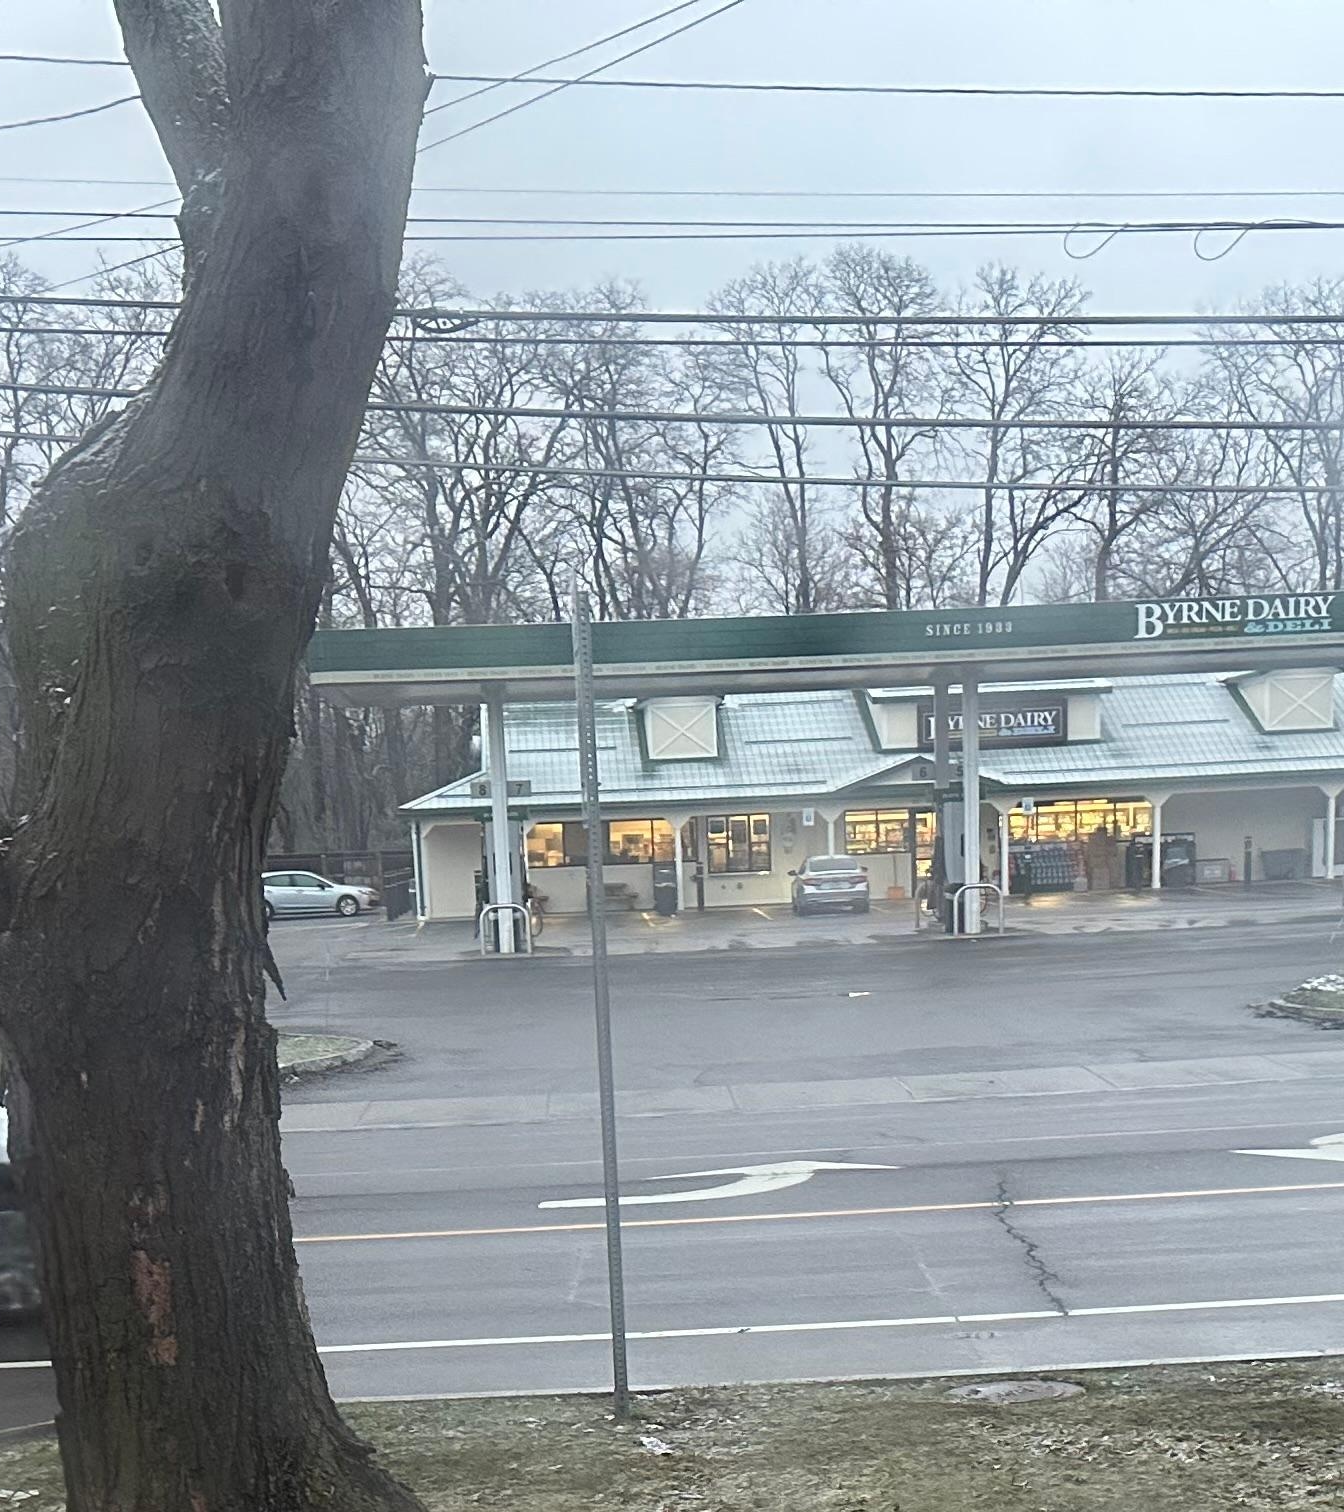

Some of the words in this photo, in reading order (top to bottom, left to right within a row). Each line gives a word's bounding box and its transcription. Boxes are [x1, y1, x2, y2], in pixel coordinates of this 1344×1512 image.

[1134, 600, 1242, 639] BYRNE
[1245, 595, 1336, 621] DAIRY
[925, 623, 971, 637] SINCE
[976, 621, 1014, 634] 1933
[999, 710, 1057, 727] DAIRY
[515, 783, 523, 794] 7
